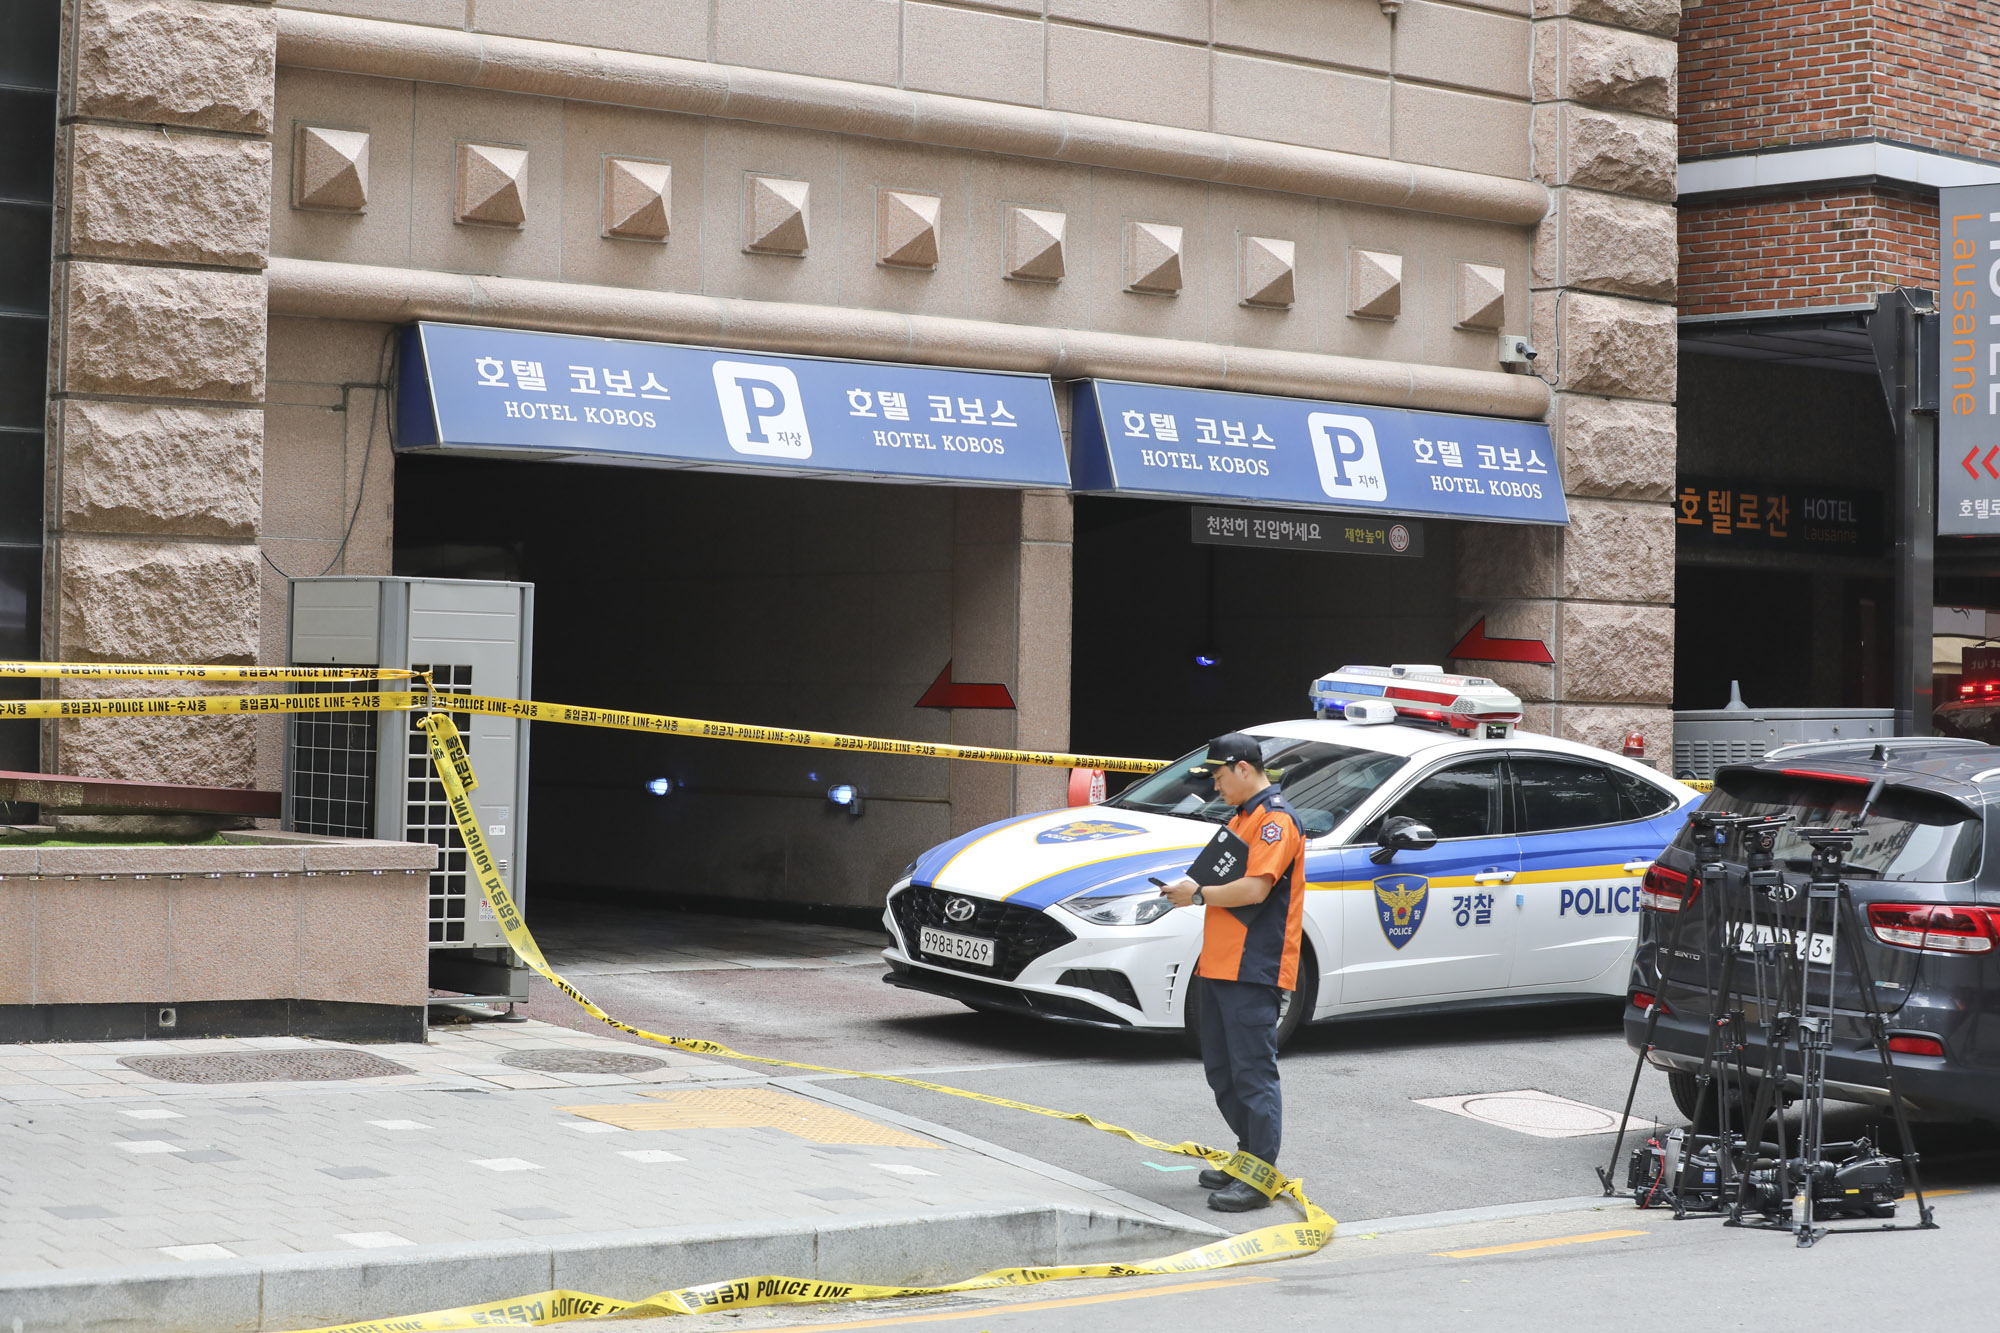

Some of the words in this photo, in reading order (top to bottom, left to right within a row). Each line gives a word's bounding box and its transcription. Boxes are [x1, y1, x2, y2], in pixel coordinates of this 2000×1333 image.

[1952, 214, 1983, 415] Lausanne
[475, 356, 547, 392] 호텔
[568, 365, 671, 400] 코보스
[504, 401, 578, 422] HOTEL
[584, 406, 657, 428] KOBOS
[734, 377, 786, 444] P
[846, 388, 910, 421] 호텔
[927, 395, 1018, 427] 코보스
[777, 431, 802, 447] 지상
[873, 430, 937, 450] HOTEL
[941, 435, 1005, 455] KOBOS
[1121, 409, 1179, 442] 호텔
[1194, 417, 1277, 450] 코보스
[1141, 449, 1203, 470] HOTEL
[1207, 455, 1270, 476] KOBOS
[1323, 425, 1364, 487] P
[1412, 438, 1464, 468] 호텔
[1476, 444, 1548, 474] 코보스
[1358, 474, 1379, 489] 지하
[1430, 475, 1485, 494] HOTEL
[1488, 480, 1543, 499] KOBOS
[1677, 487, 1790, 538] 호텔로잔
[1804, 498, 1857, 522] HOTEL
[1207, 516, 1248, 537] 천천히
[1253, 519, 1322, 541] 진입하세요
[1344, 527, 1385, 544] 제한높이
[1804, 526, 1857, 543] Lausanne
[446, 735, 474, 788] 출입금지
[1452, 893, 1494, 927] 경찰
[1560, 886, 1641, 916] POLICE
[1389, 927, 1412, 936] POLICE
[925, 932, 953, 954] 998라
[956, 939, 989, 961] 5269
[757, 1279, 811, 1298] POLICE
[813, 1284, 853, 1298] LINE
